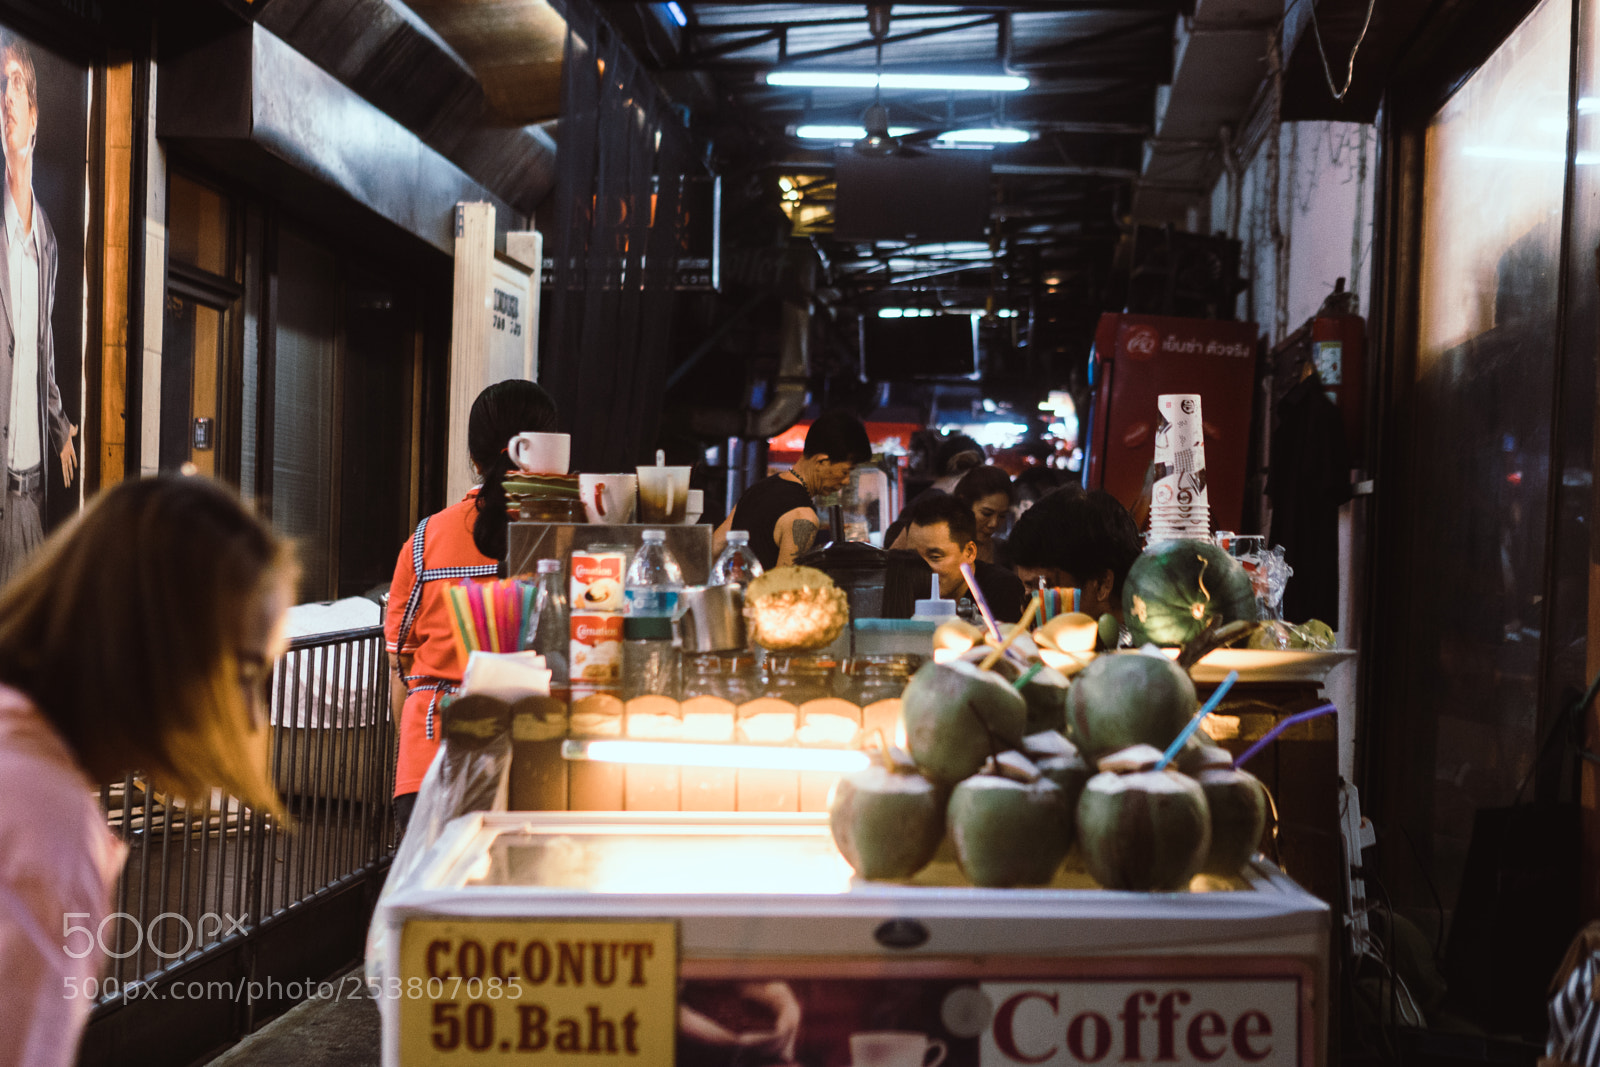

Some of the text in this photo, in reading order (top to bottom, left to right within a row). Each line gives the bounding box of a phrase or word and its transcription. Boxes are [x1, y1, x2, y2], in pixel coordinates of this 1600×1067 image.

[577, 624, 616, 639] Carnation
[425, 938, 655, 988] COCONUT
[431, 1001, 639, 1056] 50.Baht
[992, 988, 1274, 1065] Coffee
